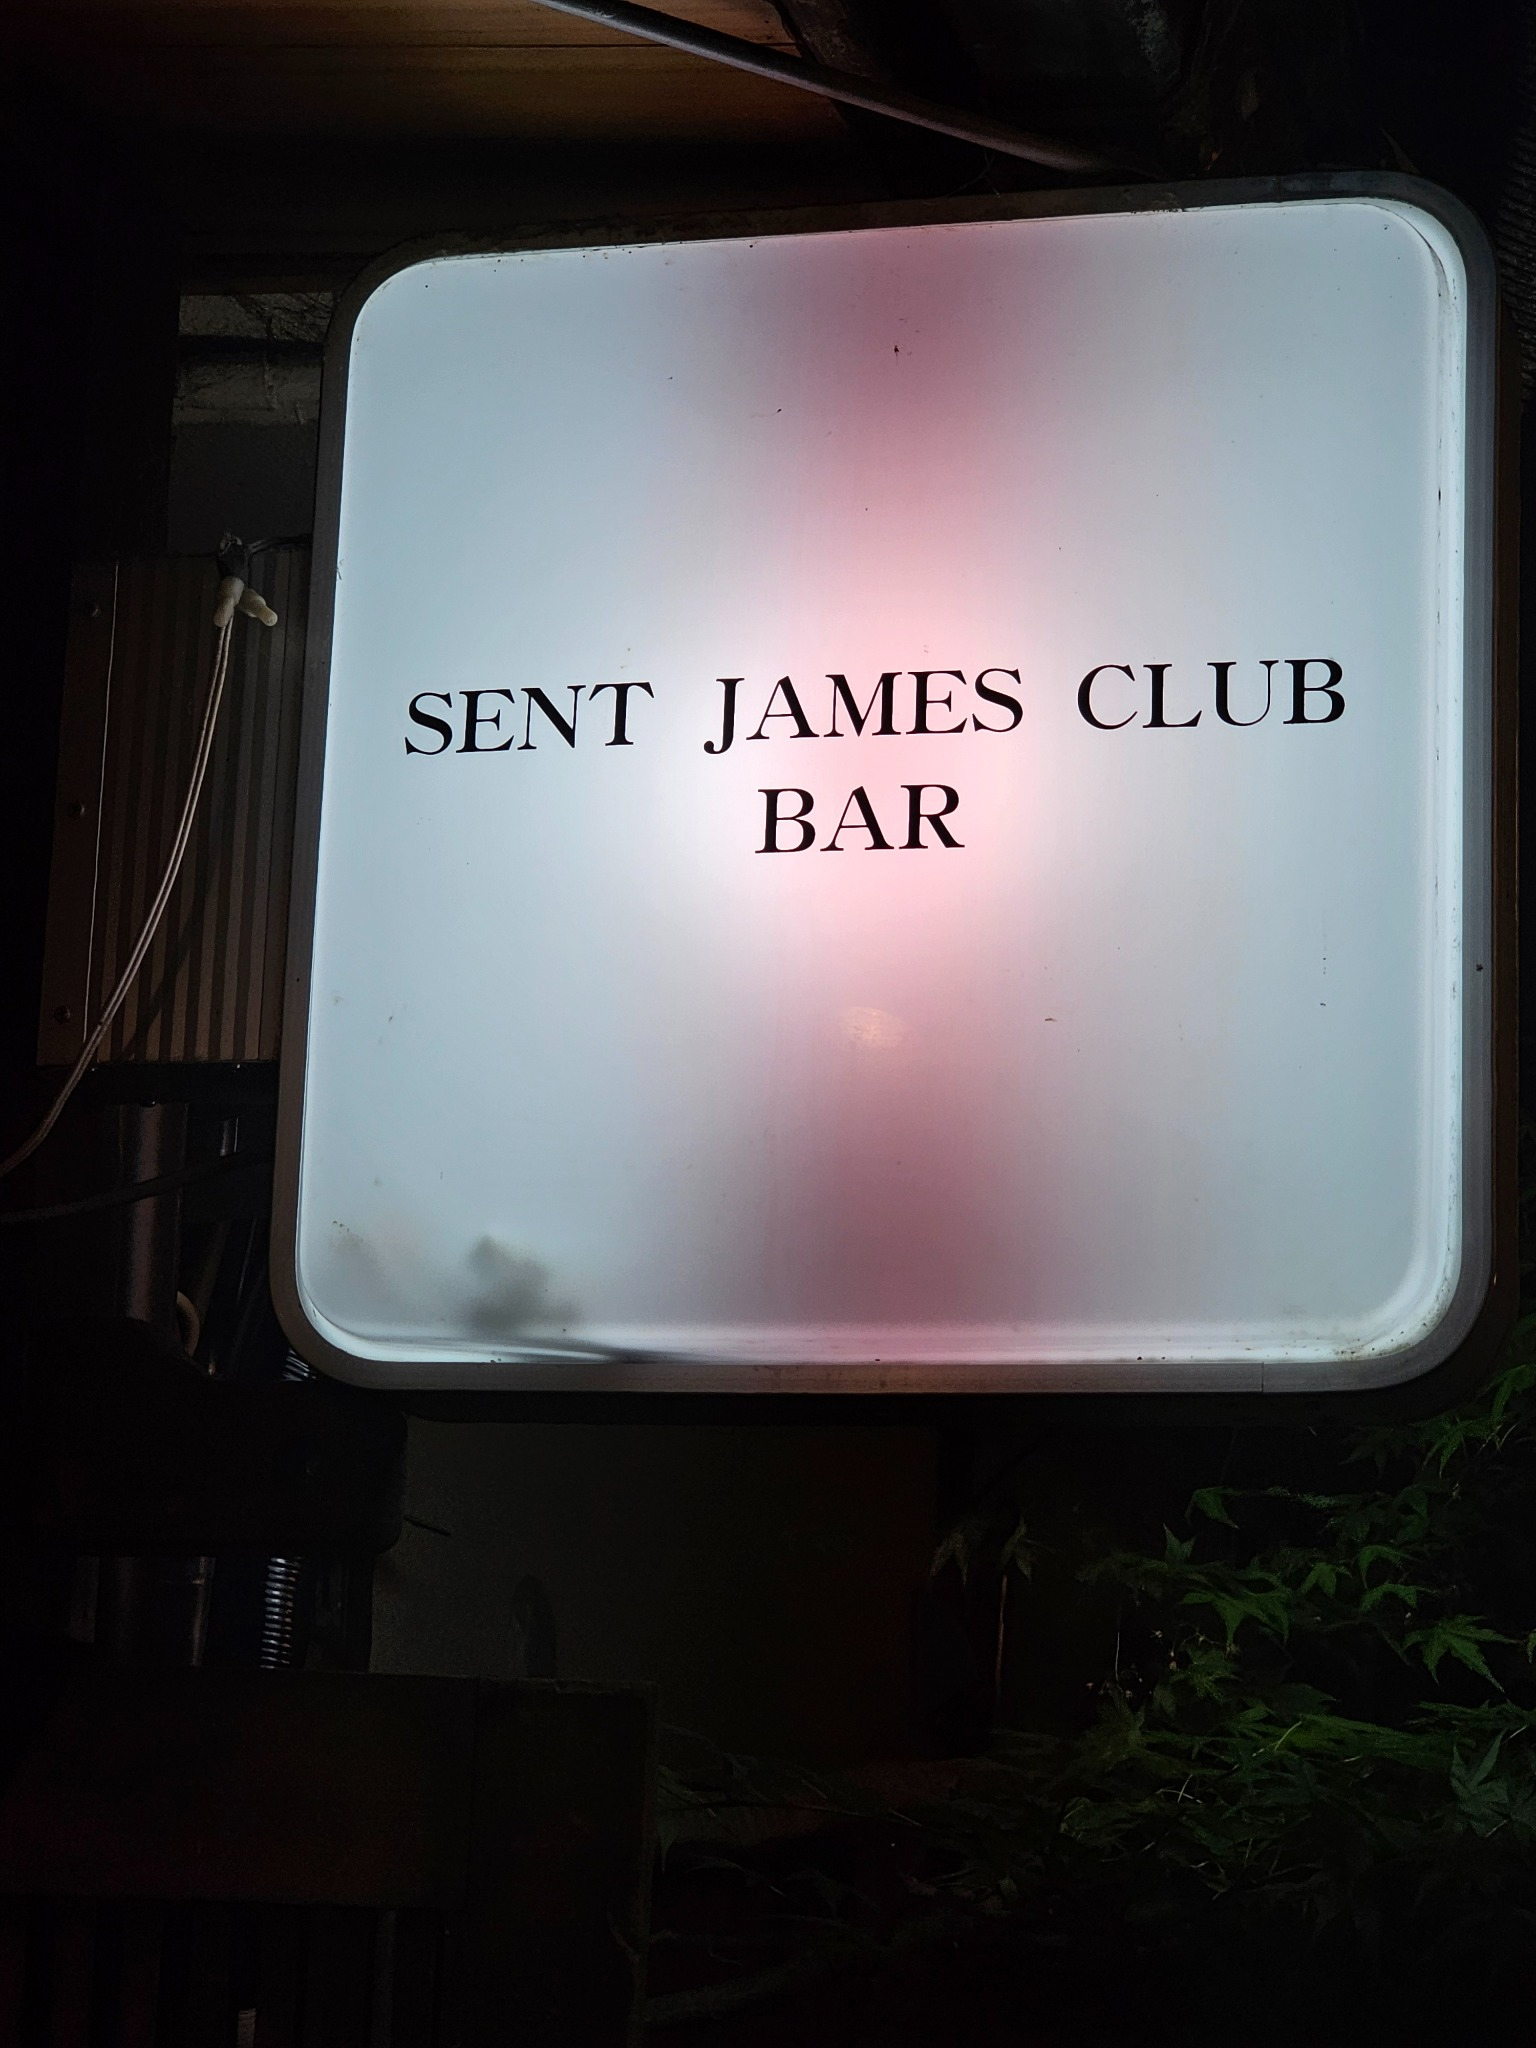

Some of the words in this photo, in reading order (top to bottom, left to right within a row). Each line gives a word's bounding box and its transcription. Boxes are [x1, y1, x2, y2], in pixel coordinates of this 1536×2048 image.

[404, 681, 654, 756] SENT
[703, 668, 1024, 755] JAMES
[1077, 657, 1346, 730] CLUB
[754, 784, 966, 854] BAR
